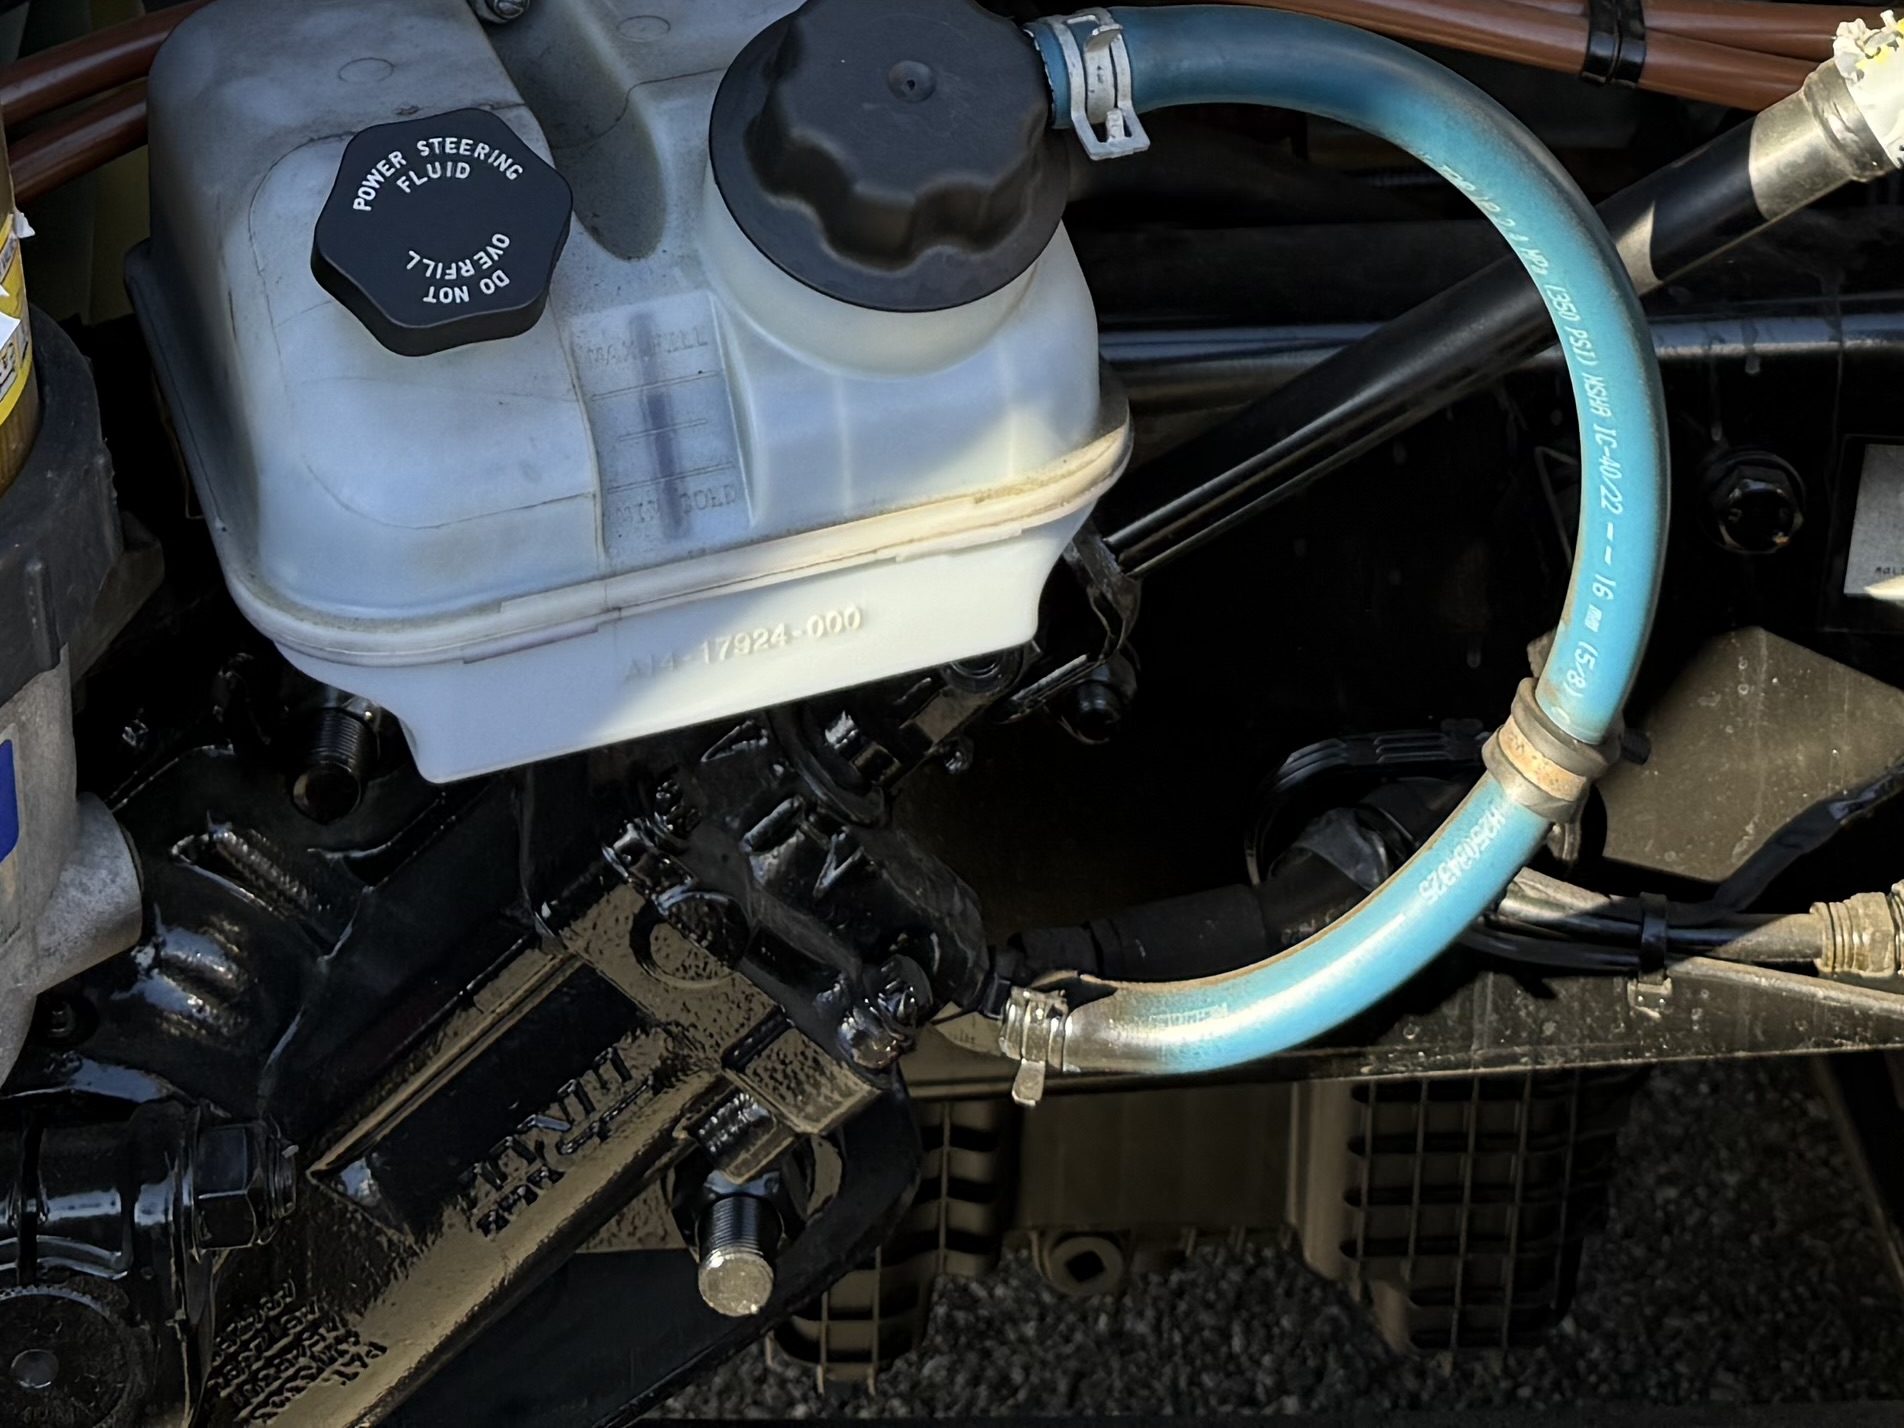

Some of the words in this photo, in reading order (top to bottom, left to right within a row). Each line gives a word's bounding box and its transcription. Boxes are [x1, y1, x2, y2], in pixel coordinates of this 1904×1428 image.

[352, 149, 408, 212] POWER
[416, 137, 524, 182] STEERING
[395, 161, 472, 194] FLUID
[405, 232, 511, 281] OVERFILL
[422, 285, 470, 305] NOT
[479, 268, 511, 295] DO
[1564, 322, 1599, 369] PSI)
[1592, 421, 1624, 516] IC-40/22
[1591, 572, 1617, 602] 16
[624, 601, 866, 685] A14-17924-000
[1564, 640, 1600, 699] (5/8)
